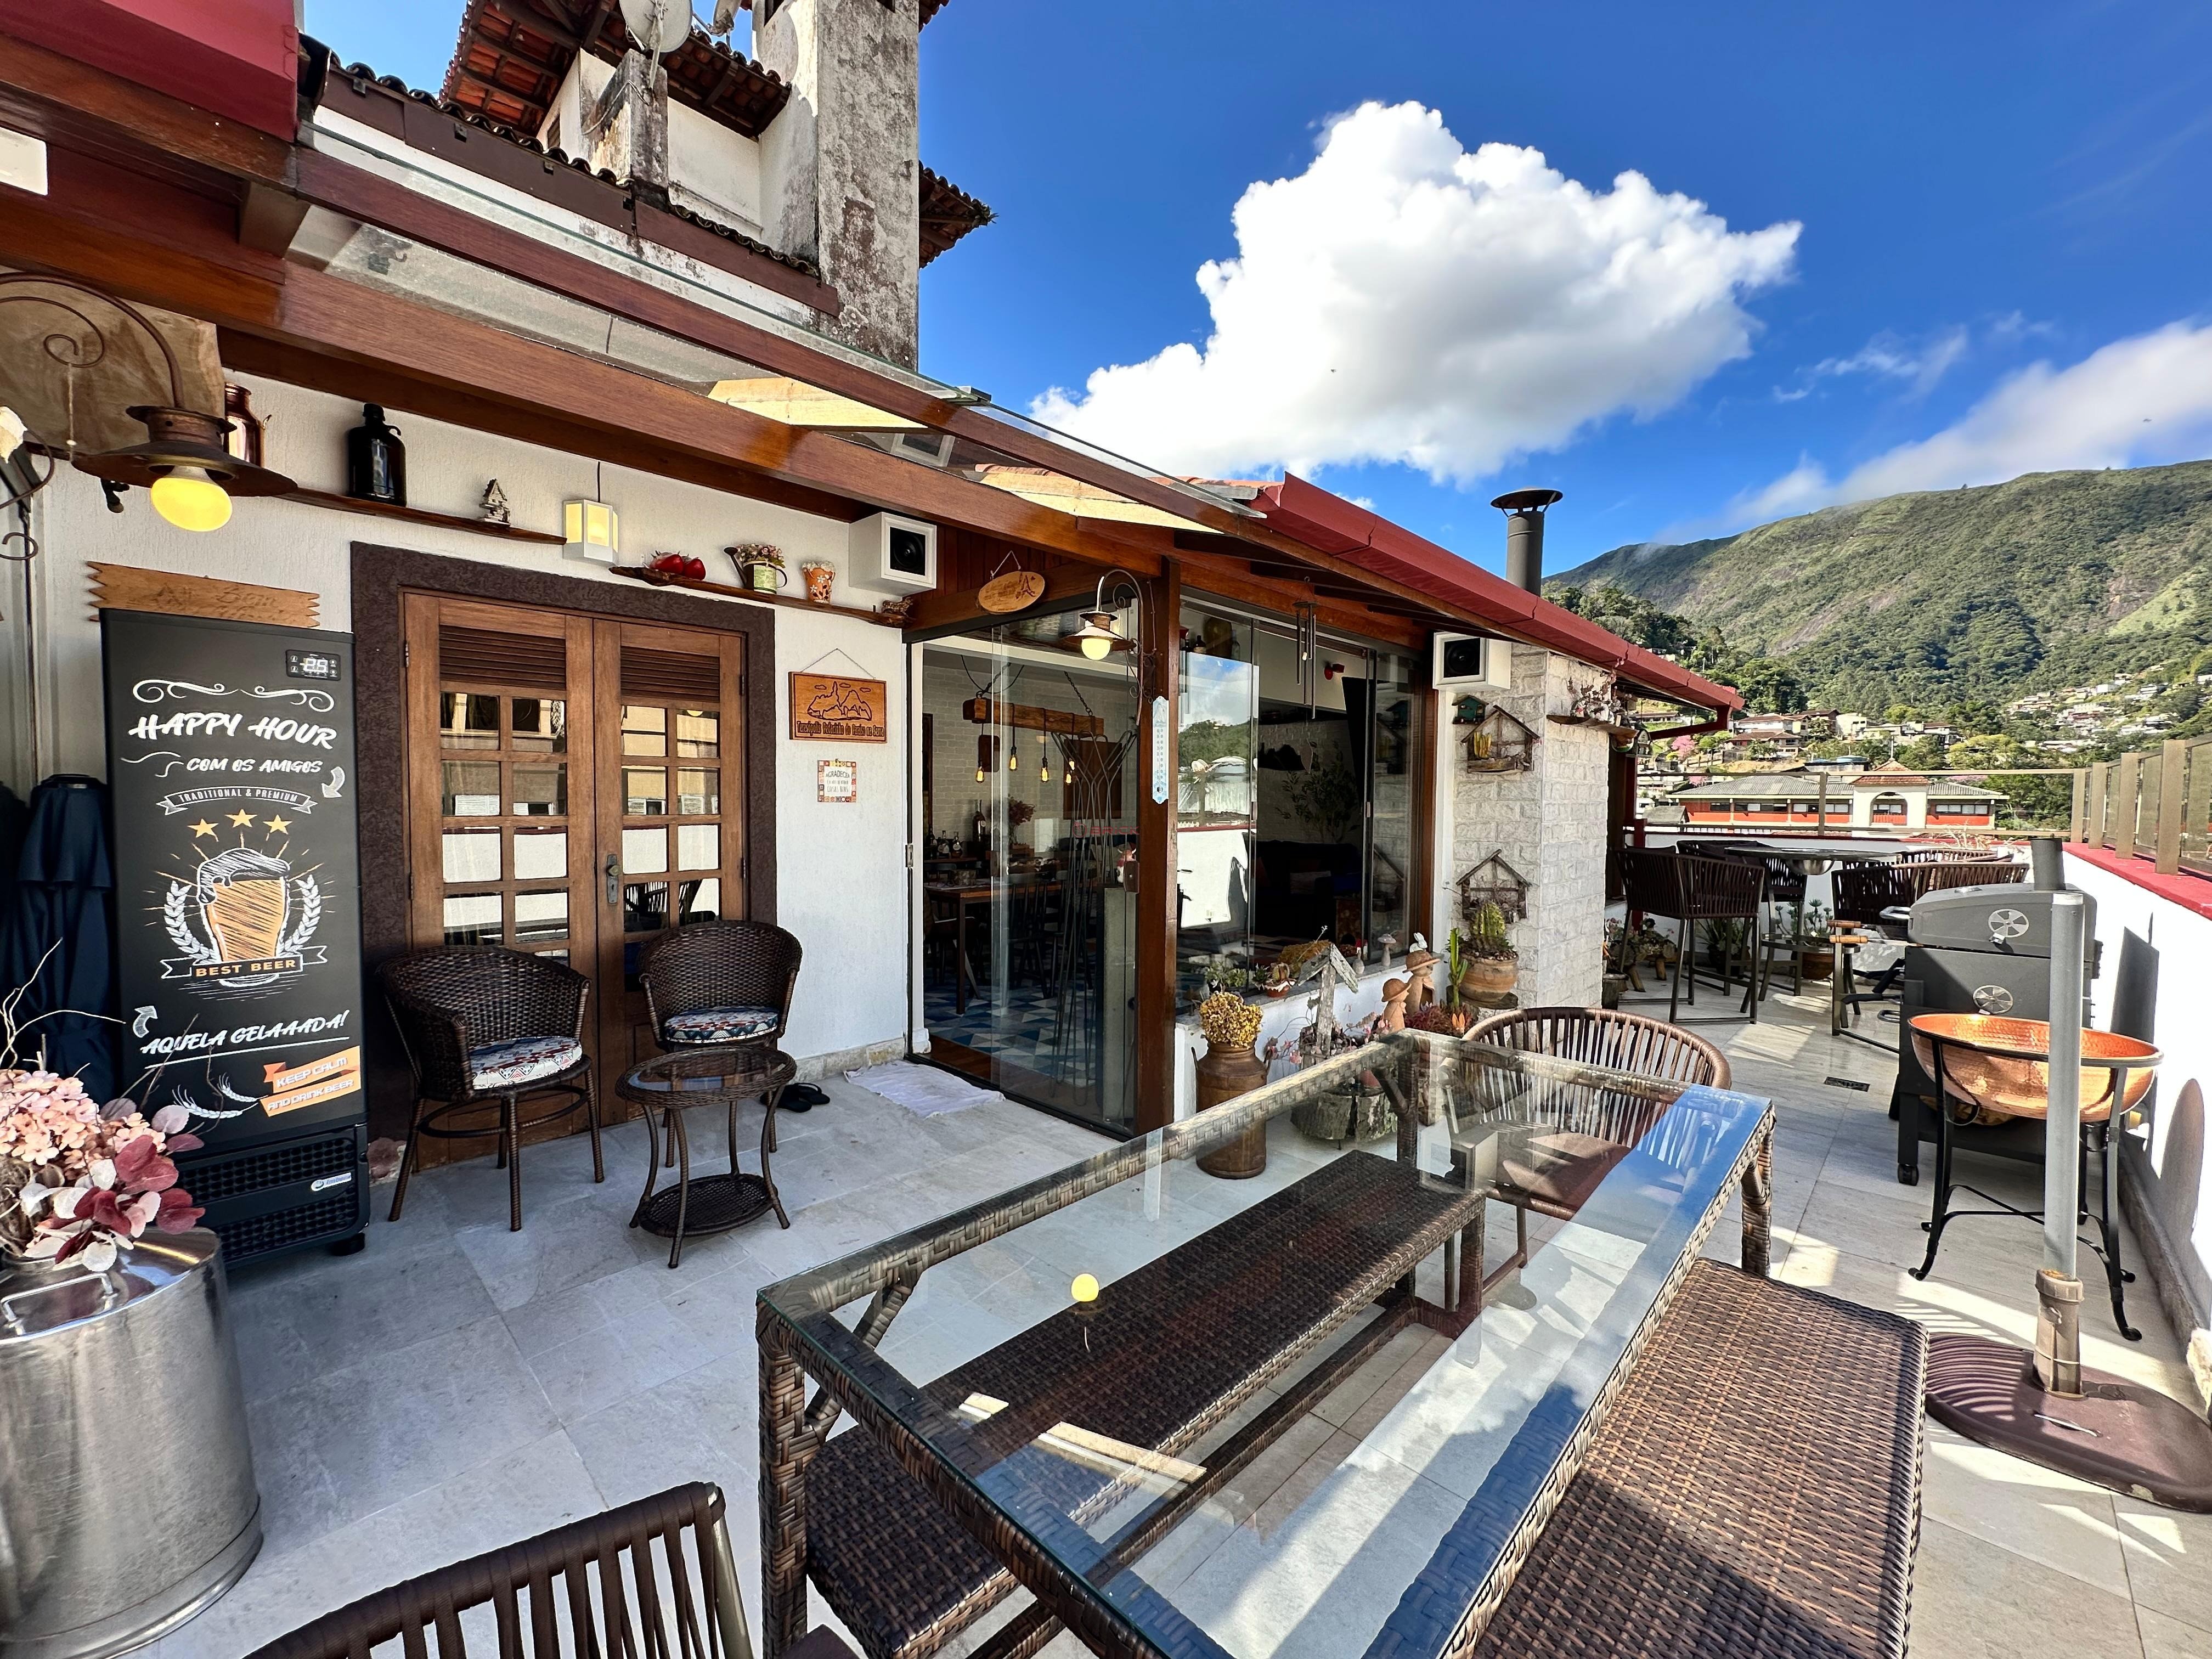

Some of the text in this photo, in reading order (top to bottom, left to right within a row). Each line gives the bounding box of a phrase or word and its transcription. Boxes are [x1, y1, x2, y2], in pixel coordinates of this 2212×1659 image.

[128, 712, 337, 750] HAPPY HOUR
[873, 724, 884, 737] Serra
[187, 758, 323, 774] COM OS AMIGOS
[178, 788, 298, 803] TRADITIONAL & PREMIUM
[196, 960, 296, 978] BEST BEER
[140, 1009, 350, 1054] AQUELA GELAAADA!
[276, 1057, 347, 1088] KEEP CALM
[268, 1079, 354, 1111] AND DRINK BEER
